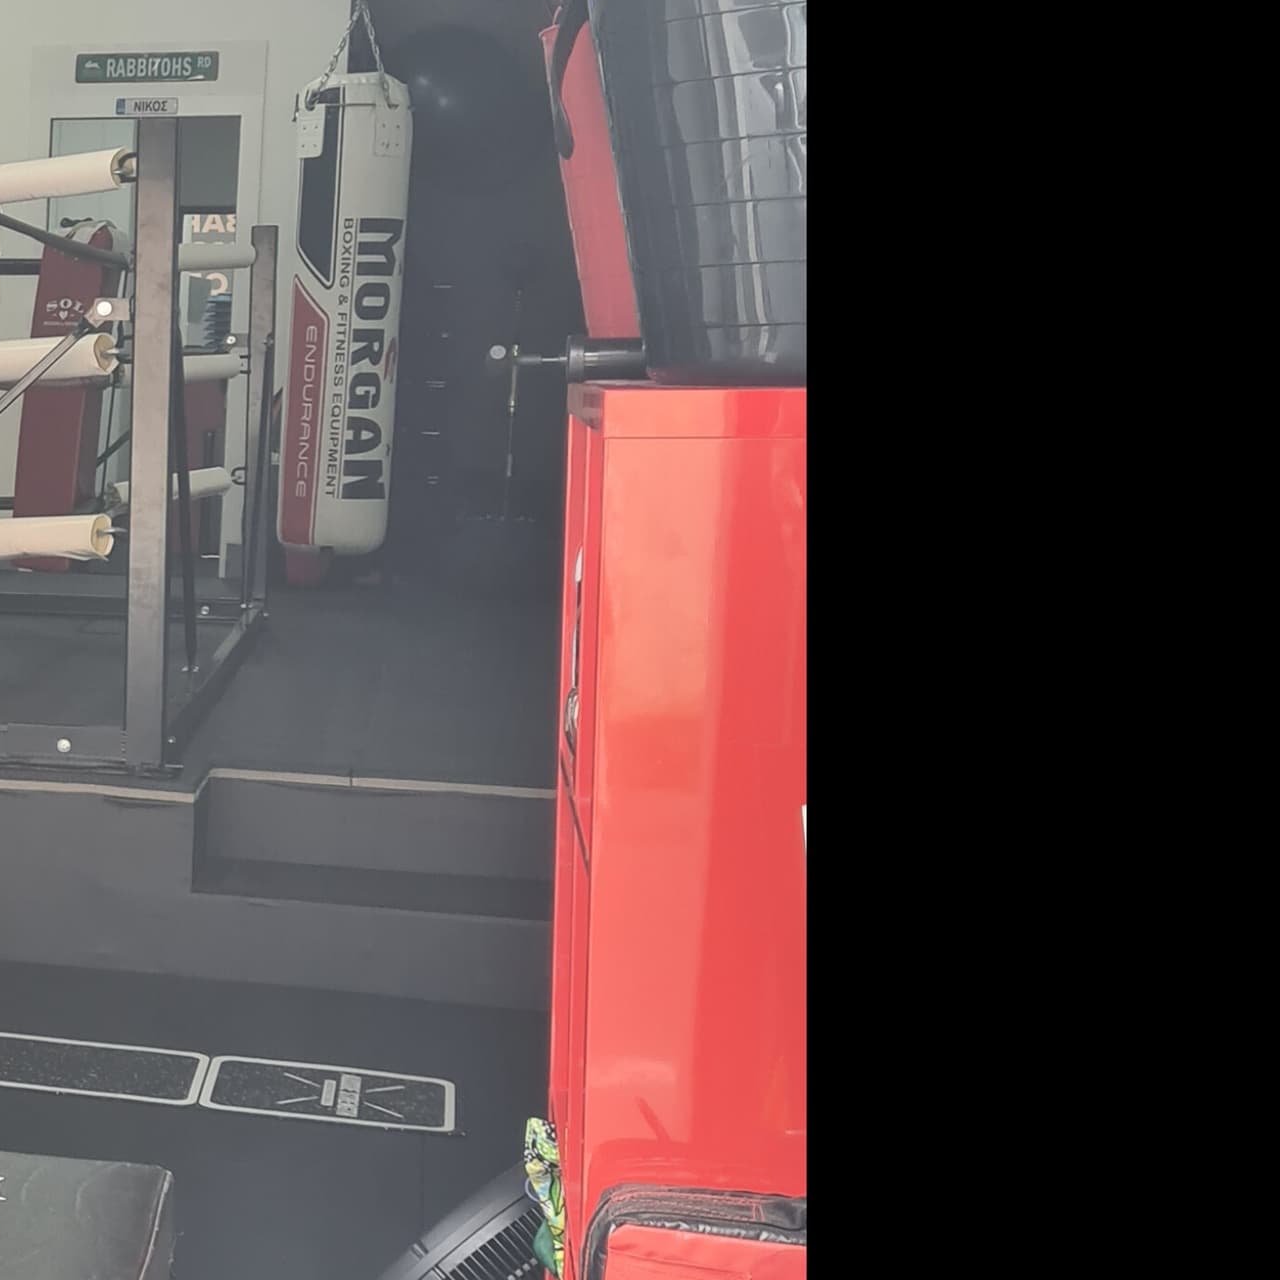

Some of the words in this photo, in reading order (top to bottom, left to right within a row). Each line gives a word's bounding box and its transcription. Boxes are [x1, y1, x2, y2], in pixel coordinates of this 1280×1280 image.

[106, 57, 192, 78] RABBITOHS
[197, 56, 212, 68] RD
[339, 218, 354, 288] BOXING
[338, 294, 349, 305] &
[333, 312, 348, 387] FITNESS
[341, 218, 405, 499] MORGAN
[296, 325, 318, 497] ENDURANCE
[325, 393, 344, 498] EQUIPMENT
